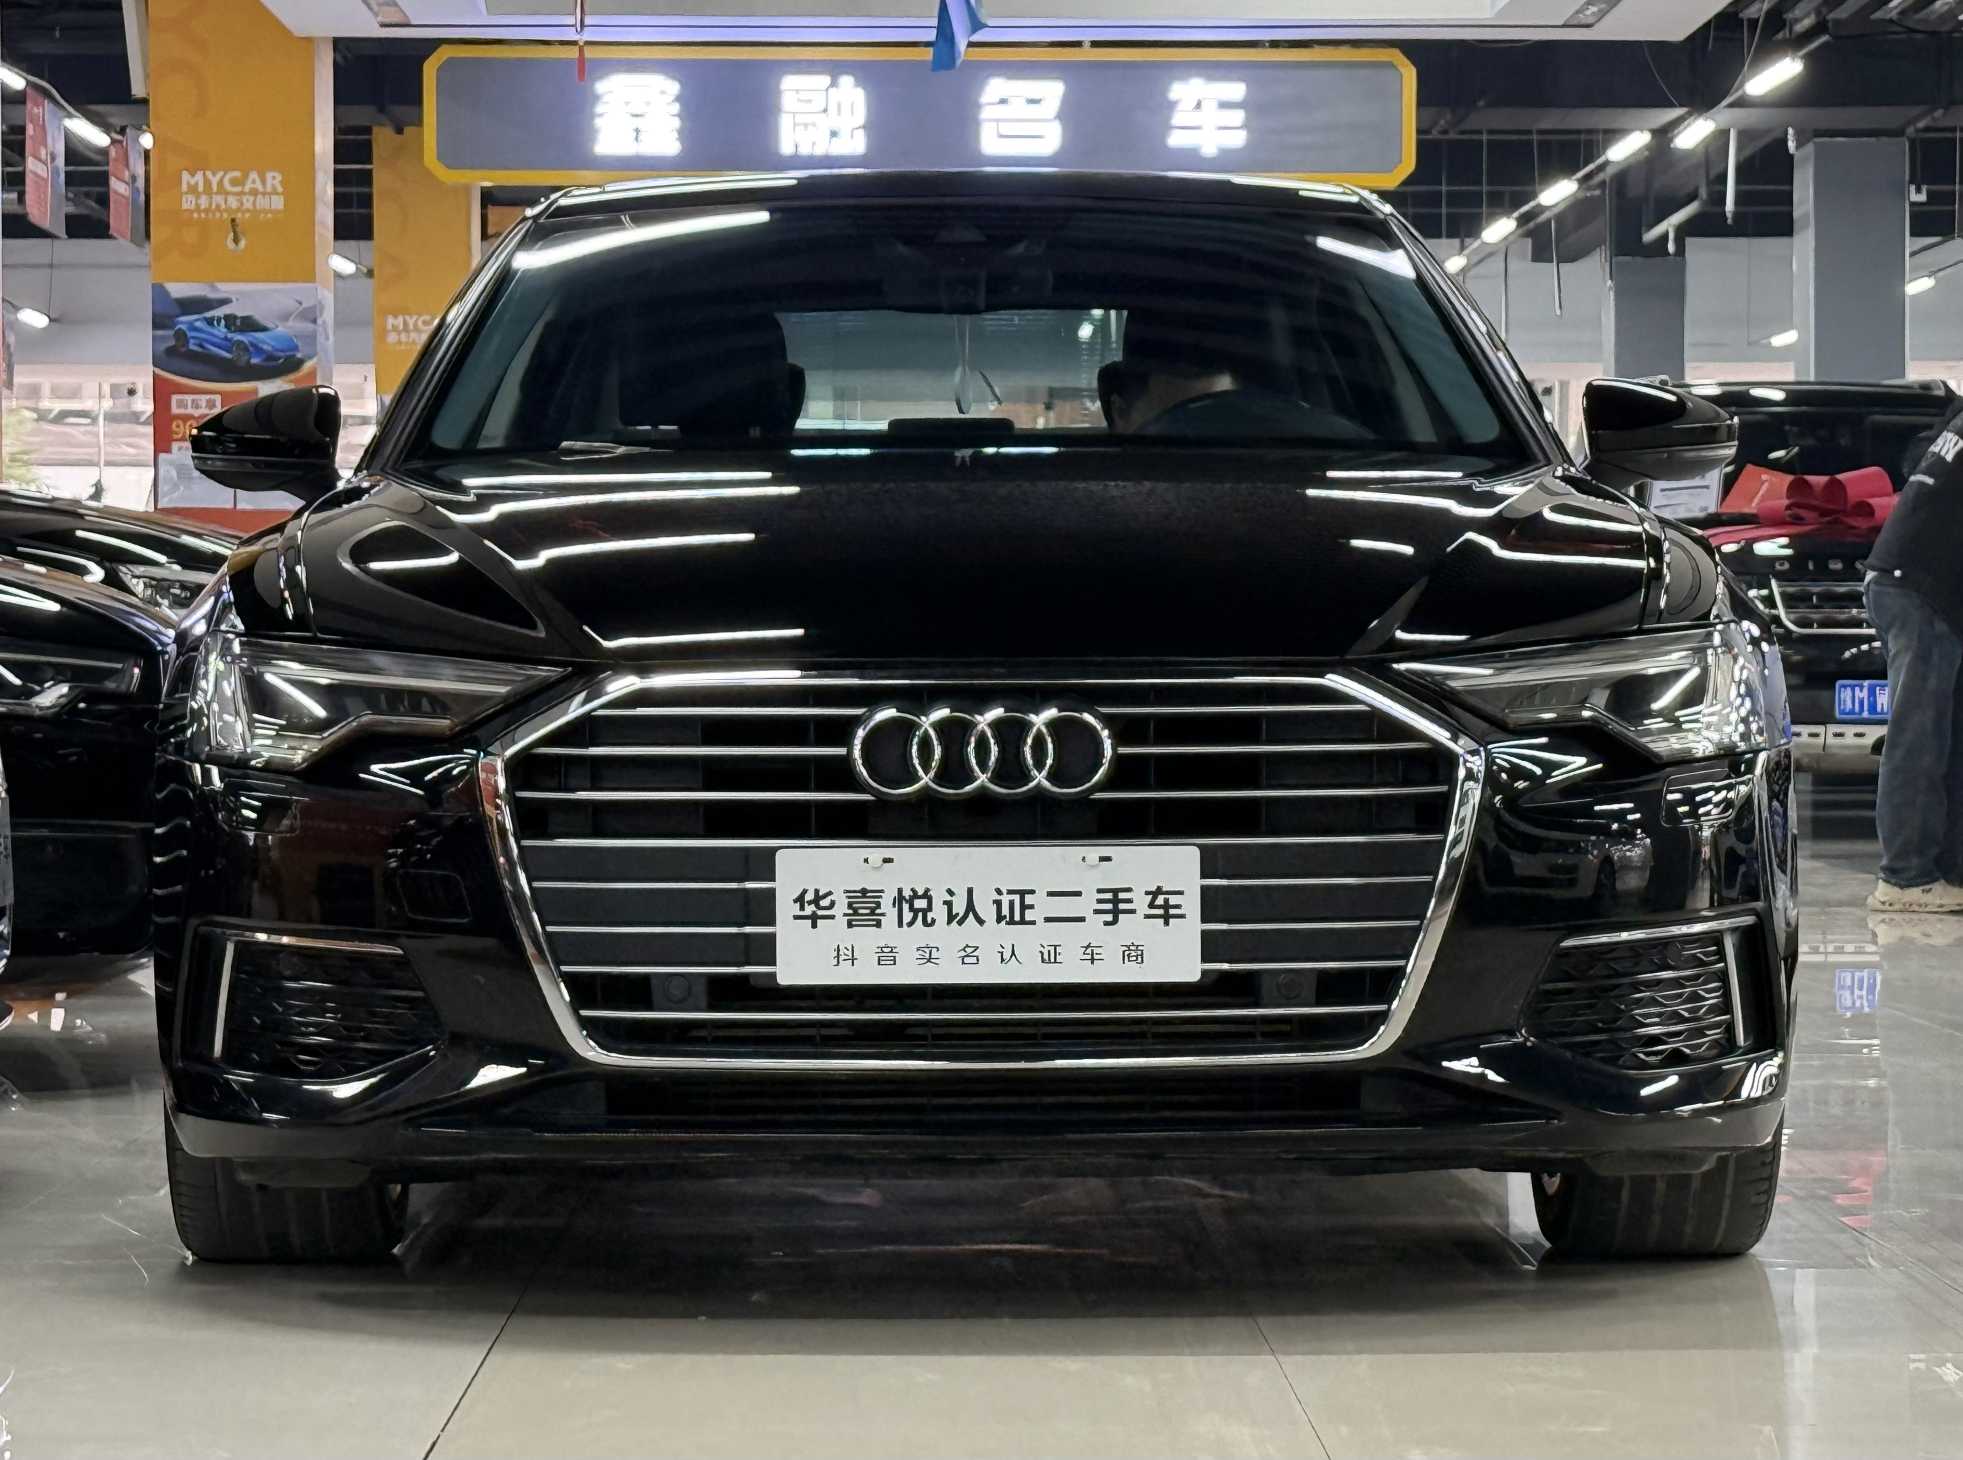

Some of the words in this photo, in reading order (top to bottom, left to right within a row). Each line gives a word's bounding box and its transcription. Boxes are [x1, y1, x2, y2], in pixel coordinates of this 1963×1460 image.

[593, 73, 1248, 157] 鑫融名车
[181, 170, 284, 192] MYCAR
[792, 885, 1187, 929] 华喜悦认证二手车
[832, 943, 1145, 968] 抖音实名认证车商
